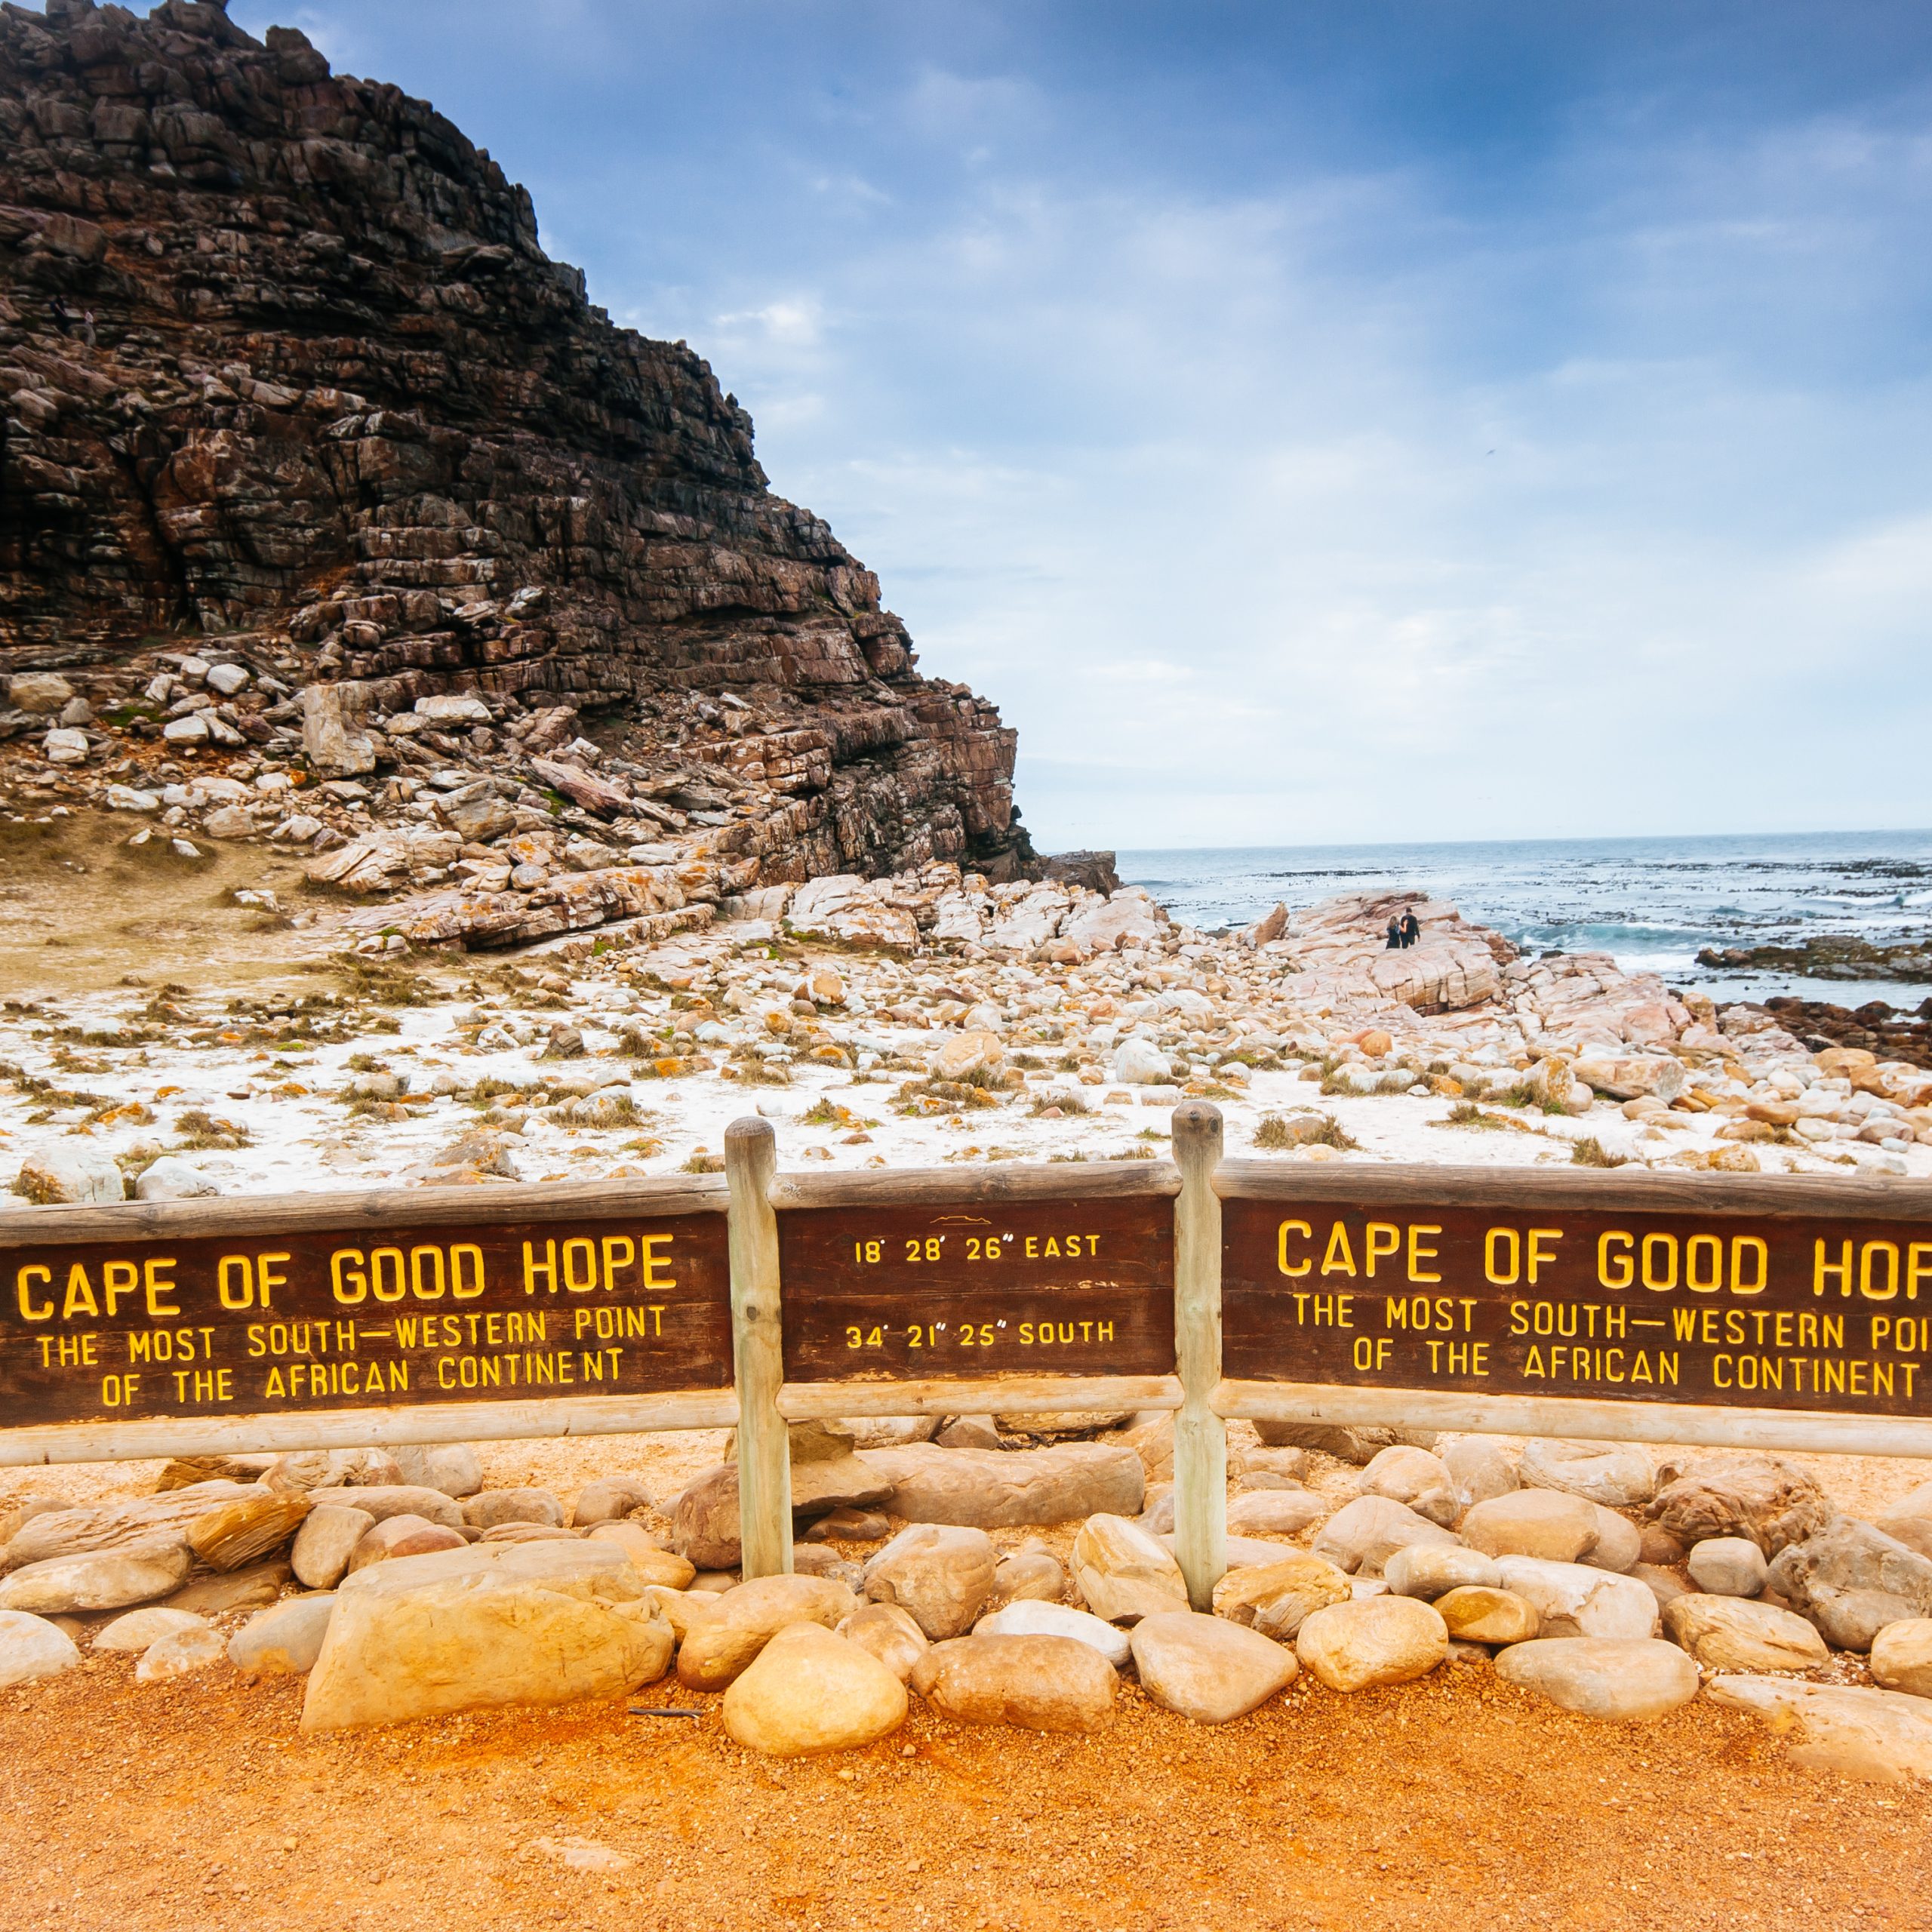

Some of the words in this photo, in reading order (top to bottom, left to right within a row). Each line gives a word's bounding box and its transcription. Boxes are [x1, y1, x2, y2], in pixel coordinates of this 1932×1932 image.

[1025, 1235, 1100, 1258] EAST
[1278, 1220, 1441, 1281] CAPE
[1485, 1228, 1563, 1284] OF
[1598, 1231, 1767, 1294] GOOD
[18, 1260, 180, 1320] CAPE
[219, 1253, 291, 1309] OF
[331, 1244, 485, 1303] GOOD
[523, 1235, 676, 1294] HOPE
[36, 1334, 98, 1367] THE
[129, 1327, 214, 1363] MOST
[576, 1306, 665, 1340] POINT
[1019, 1321, 1114, 1345] SOUTH
[1293, 1294, 1354, 1328] THE
[1387, 1297, 1477, 1332] MOST
[103, 1374, 140, 1407] OF
[172, 1369, 233, 1402] THE
[266, 1360, 408, 1398] AFRICAN
[438, 1348, 623, 1389] CONTINENT
[1354, 1337, 1393, 1371] OF
[1426, 1340, 1489, 1376] THE
[1524, 1346, 1678, 1386] AFRICAN
[1714, 1353, 1920, 1398] CONTINENT
